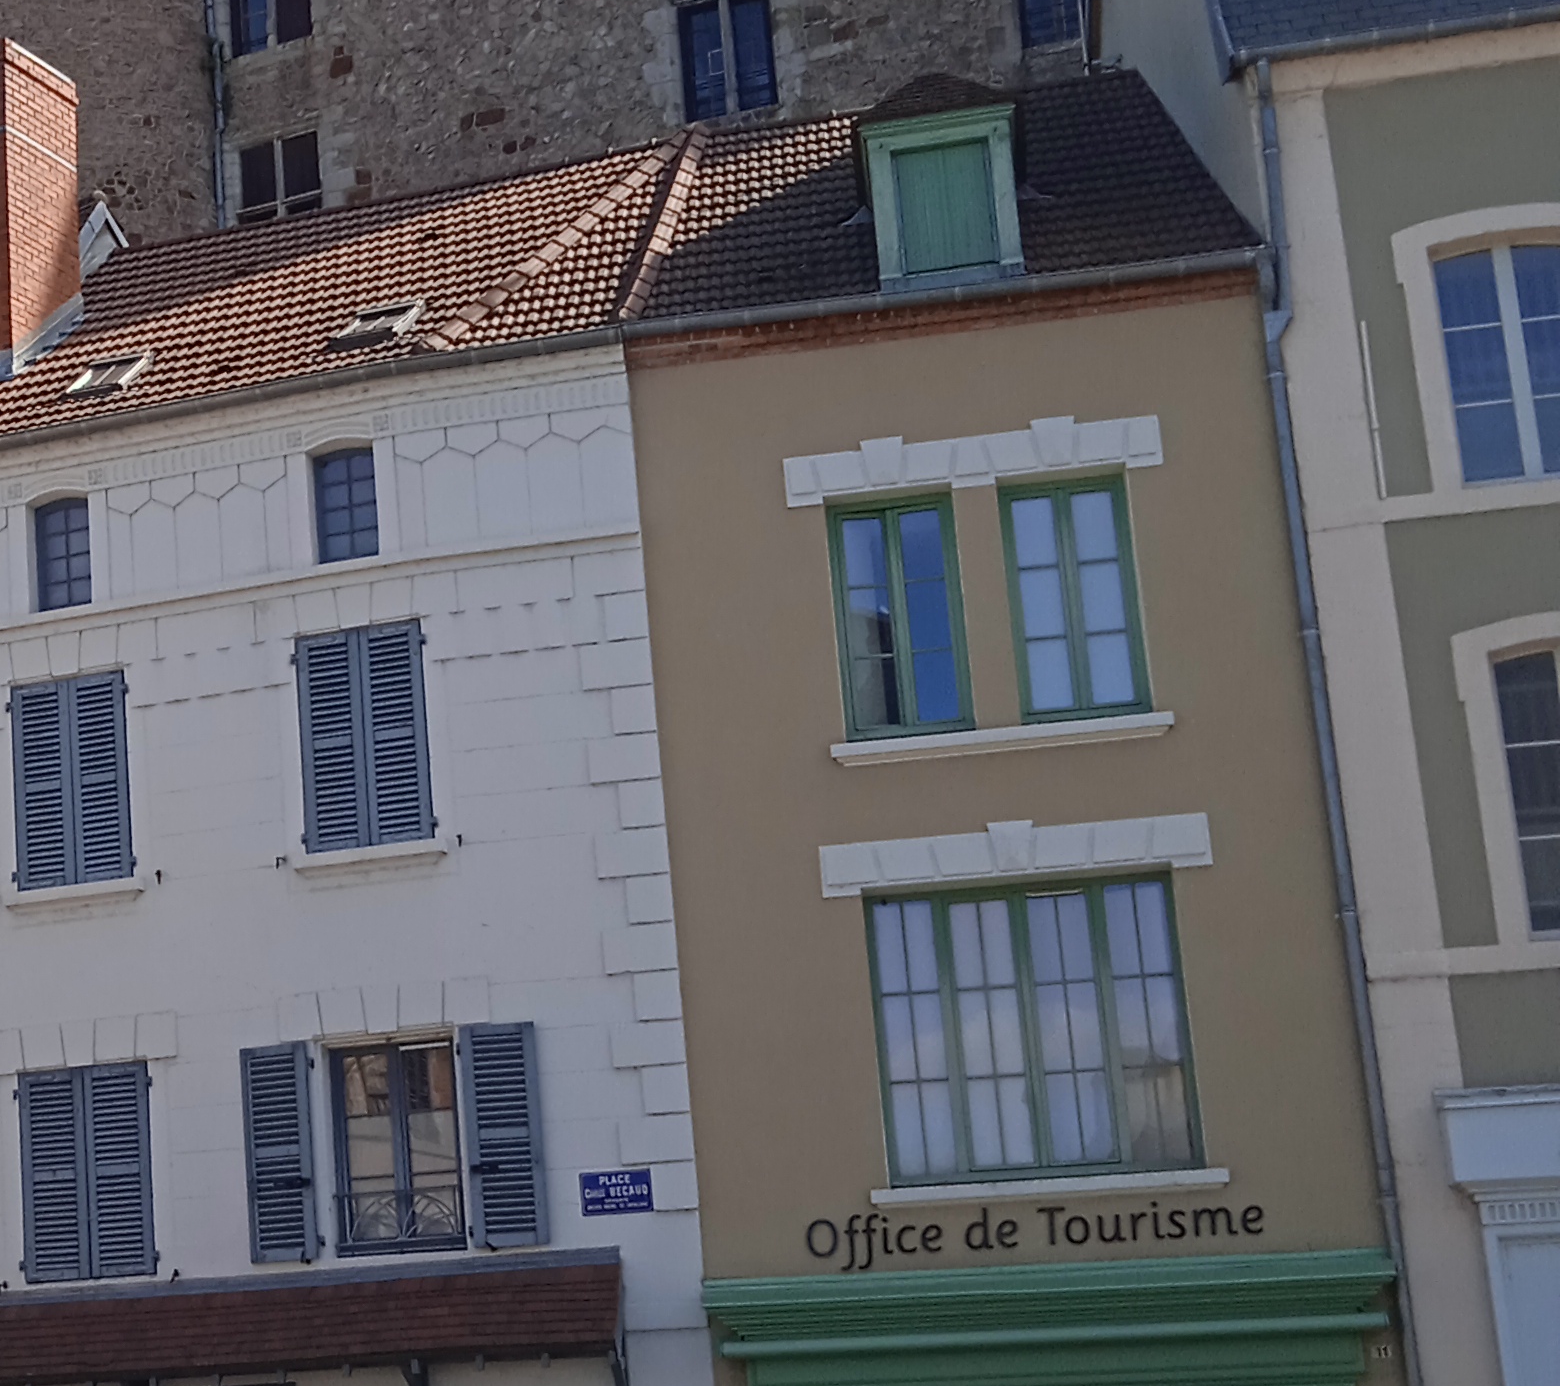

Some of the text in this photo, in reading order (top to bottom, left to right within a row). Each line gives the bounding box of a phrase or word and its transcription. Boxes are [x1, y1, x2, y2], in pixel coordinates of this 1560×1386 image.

[598, 1174, 631, 1186] PLACE
[807, 1201, 1265, 1271] Office de Tourisme
